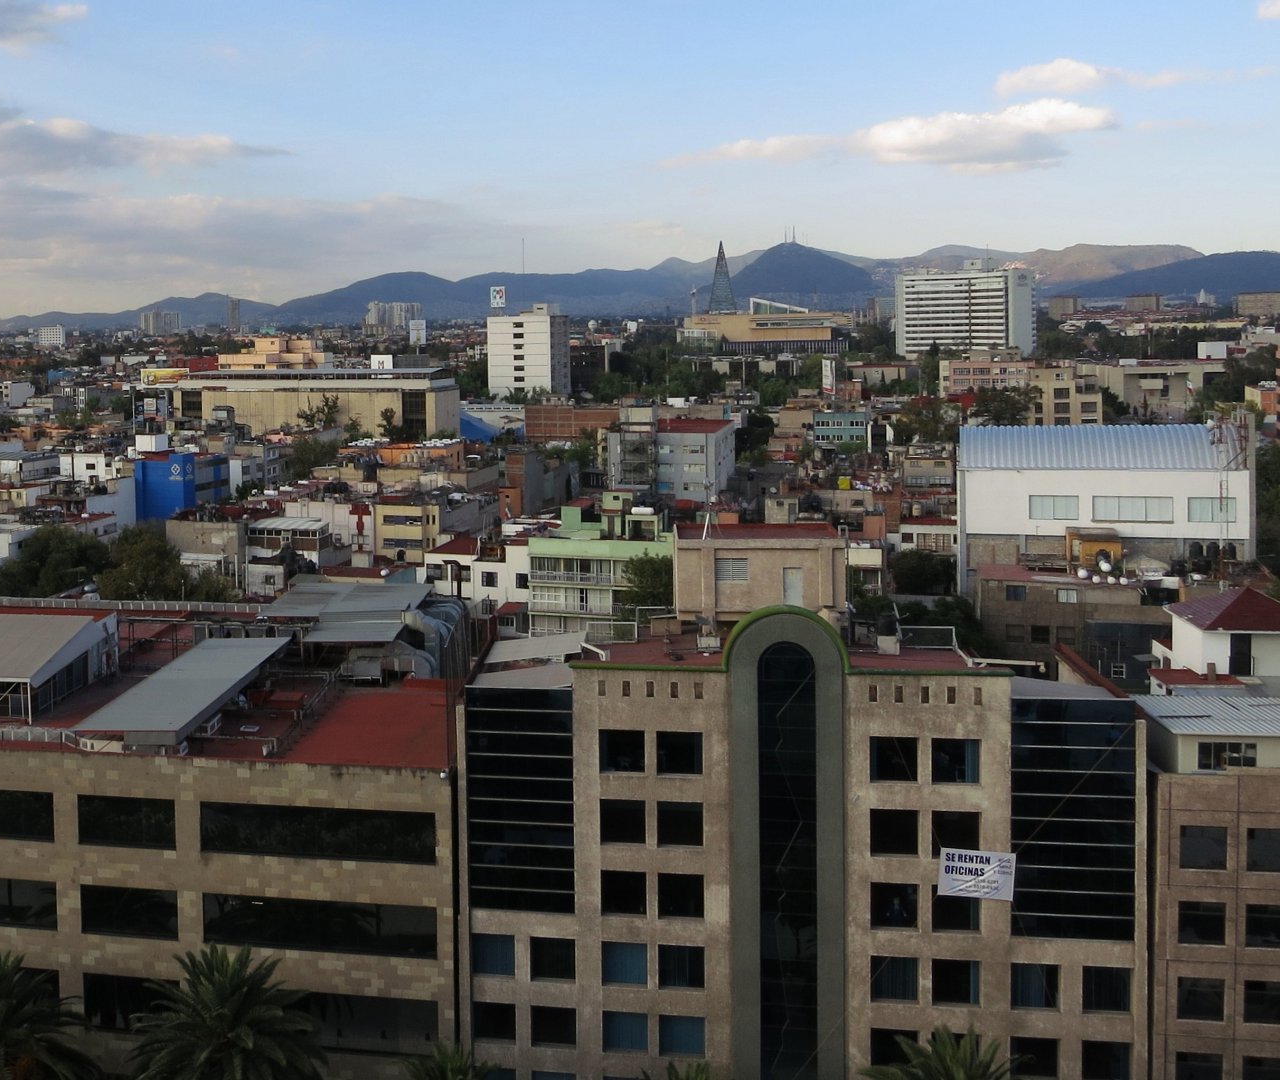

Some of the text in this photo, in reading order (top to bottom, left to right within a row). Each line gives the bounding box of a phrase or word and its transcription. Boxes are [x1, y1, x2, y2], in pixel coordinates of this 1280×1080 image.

[945, 852, 956, 862] SE
[957, 853, 991, 865] RENTAN
[944, 865, 984, 876] OFICINAS
